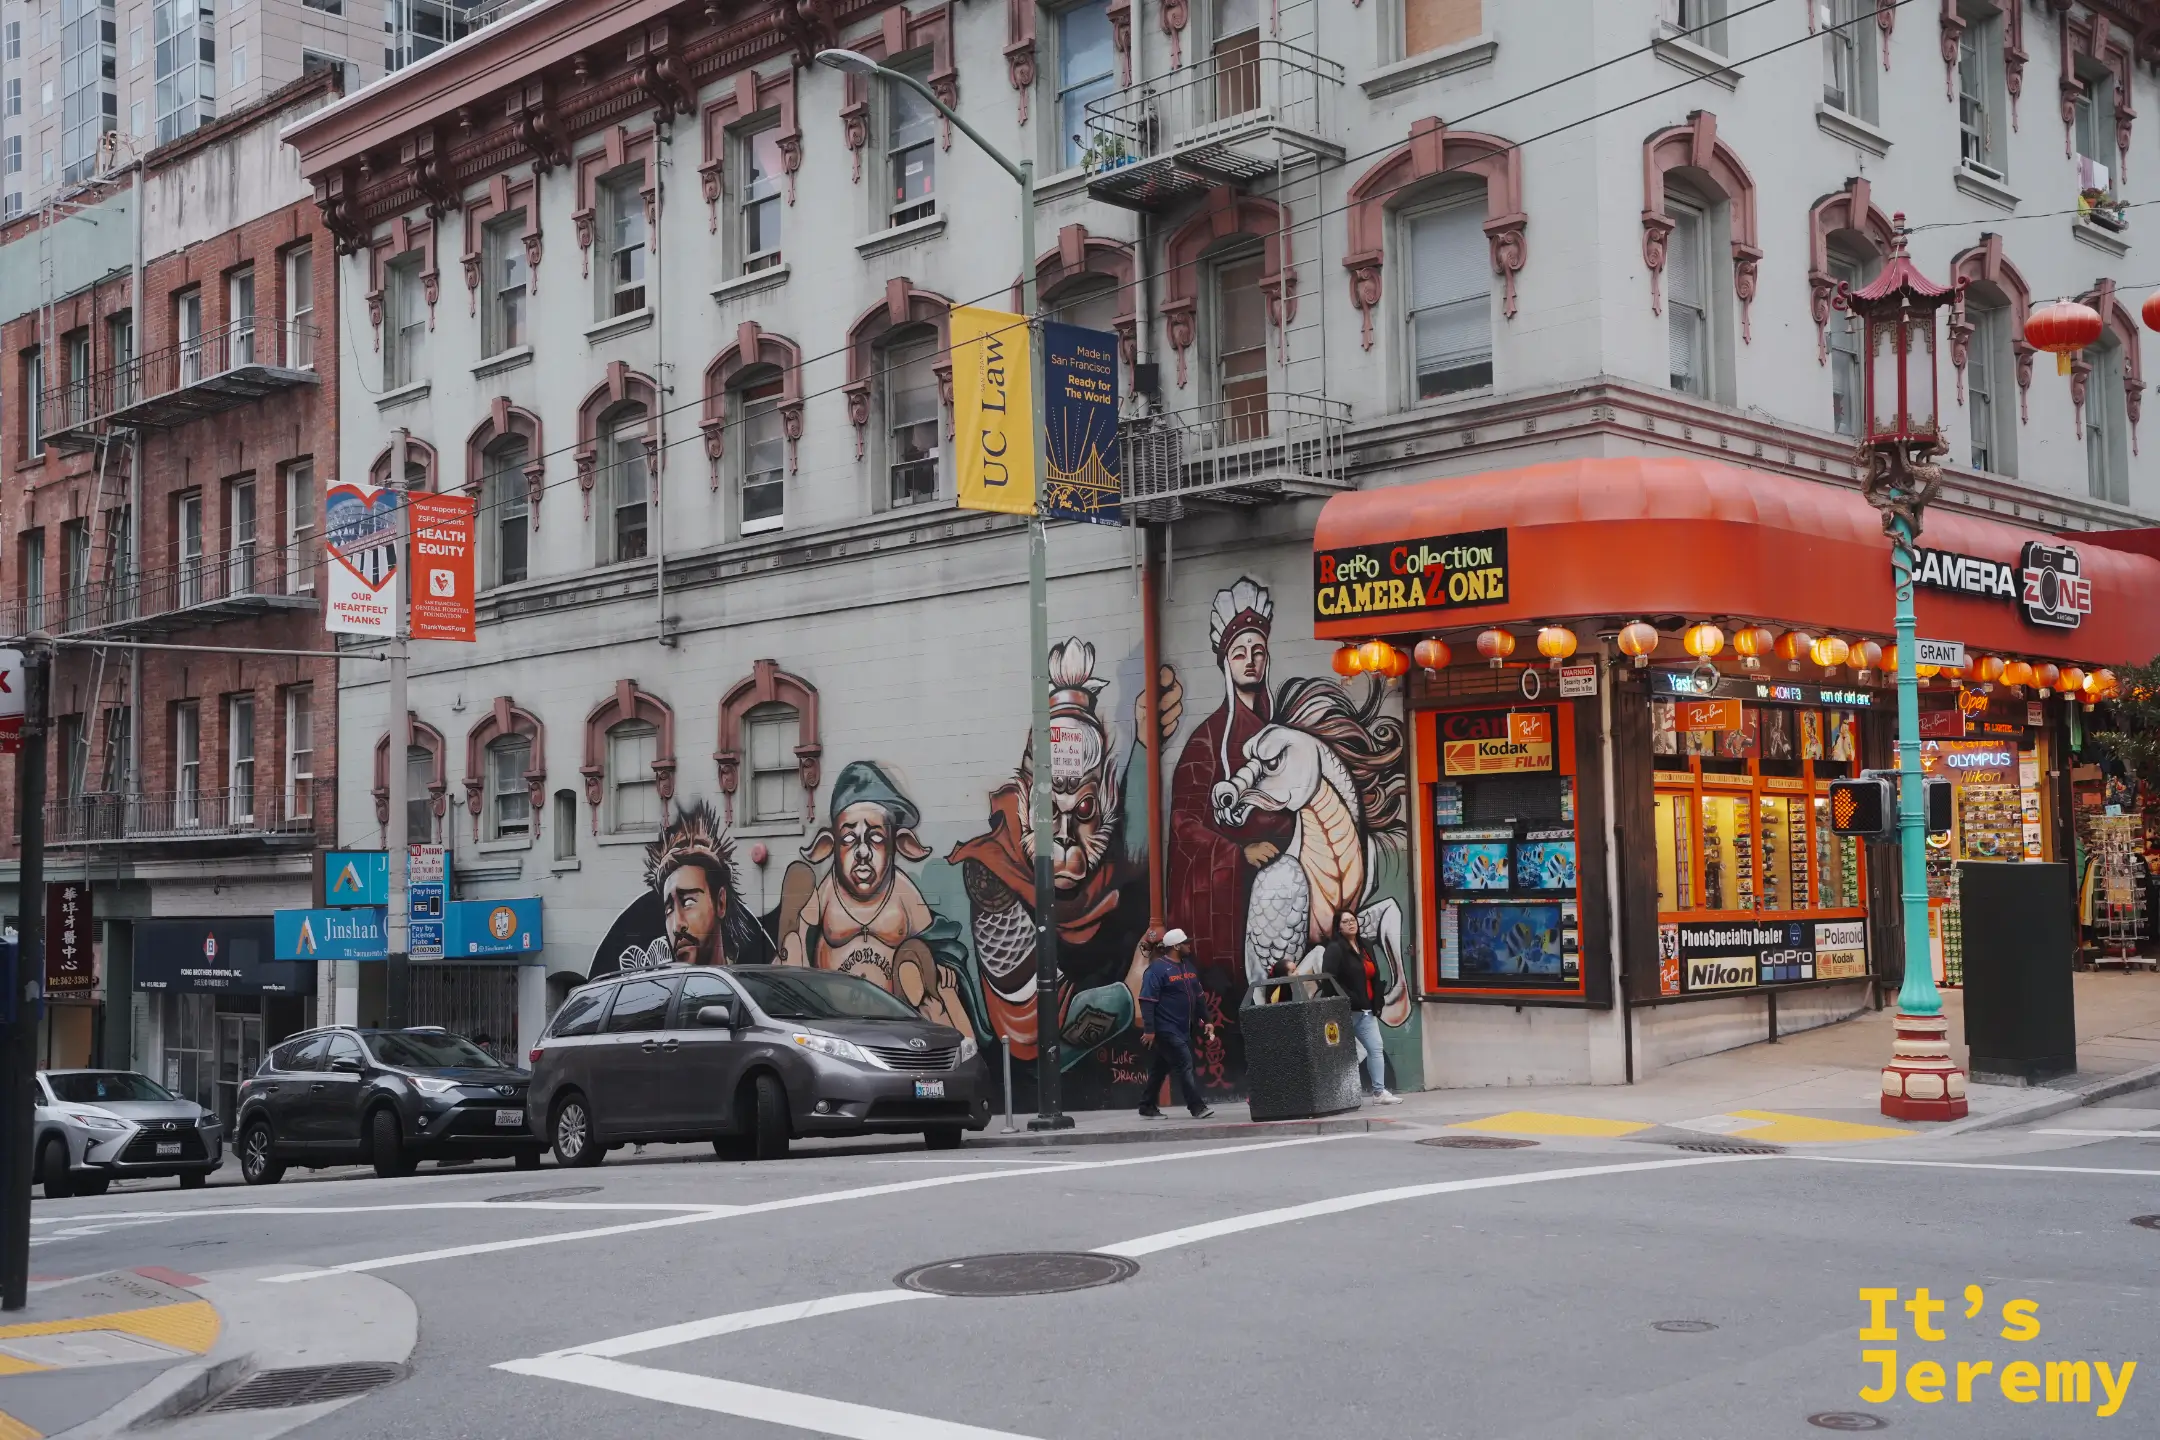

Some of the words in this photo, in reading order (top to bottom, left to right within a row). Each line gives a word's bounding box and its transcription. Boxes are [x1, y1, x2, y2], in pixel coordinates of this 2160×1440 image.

[1077, 346, 1100, 359] Made
[1102, 350, 1111, 361] in
[1051, 353, 1068, 366] San
[1070, 357, 1111, 375] Francisco
[982, 332, 1006, 415] Law
[1068, 374, 1096, 390] Ready
[1098, 380, 1111, 391] for
[1065, 387, 1082, 399] The
[1084, 391, 1111, 405] World
[982, 430, 1009, 488] UC
[431, 506, 456, 514] support
[418, 515, 436, 523] ZSFG
[417, 528, 466, 543] HEALTH
[418, 542, 464, 557] EQUITY
[1911, 548, 2017, 597] CAMERA
[351, 592, 372, 601] OUR
[2024, 566, 2089, 614] ZONE
[333, 602, 388, 614] HEARTFELT
[416, 604, 442, 612] GENERAL
[442, 606, 469, 614] HOSPITAL
[423, 611, 462, 619] FOUNDATION
[341, 614, 381, 625] THANKS
[420, 623, 466, 632] ThankYouSF.org
[1920, 644, 1956, 662] GRANT
[1563, 668, 1593, 677] WARNING
[1563, 678, 1580, 686] Security
[1667, 674, 1708, 692] Yasha
[1834, 691, 1843, 703] of
[1844, 690, 1856, 705] old
[1959, 690, 1989, 716] Open
[1690, 703, 1723, 723] Ray-Ban
[1444, 715, 1508, 740] Can
[1919, 713, 1948, 731] Ray-Ban
[0, 731, 19, 741] Stop
[1050, 728, 1060, 740] NO
[1061, 731, 1082, 742] PARKING
[1479, 742, 1528, 756] Kodak
[1515, 754, 1551, 769] FILM
[1947, 752, 2011, 768] OLYMPUS
[1960, 771, 2001, 783] Nikon
[412, 846, 420, 855] NO
[422, 847, 443, 855] PARKING
[412, 888, 424, 896] Pay
[61, 887, 78, 970] 華埠牙醫中心
[324, 917, 378, 941] Jinshan
[412, 925, 424, 933] Pay
[425, 925, 434, 933] by
[1824, 926, 1864, 945] Polaroid
[1753, 928, 1783, 945] Dealer
[353, 949, 382, 957] Sacramento
[1760, 950, 1813, 965] GoPro
[1832, 953, 1855, 964] Kodak
[213, 969, 232, 978] PRINTING,
[1691, 963, 1754, 985] Nikon
[1848, 964, 1864, 973] FILM
[1111, 1047, 1138, 1065] LUKE
[1110, 1067, 1149, 1085] DRAGON
